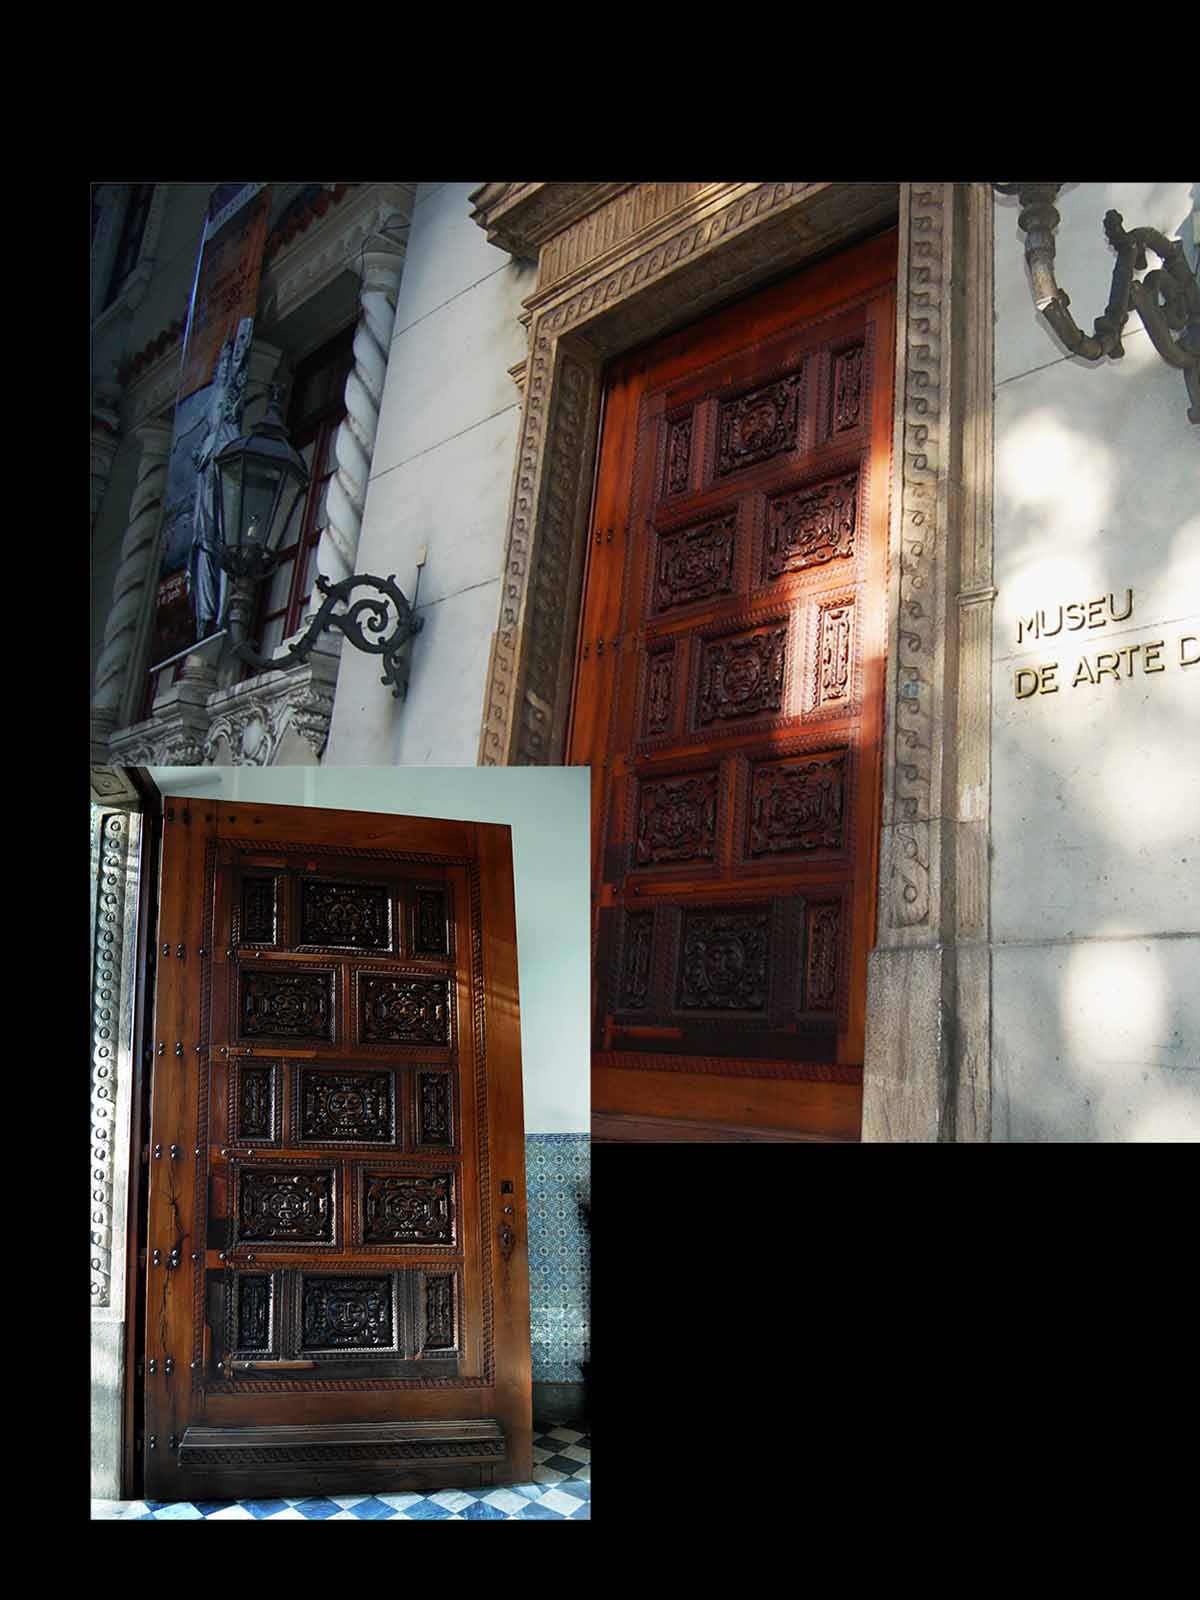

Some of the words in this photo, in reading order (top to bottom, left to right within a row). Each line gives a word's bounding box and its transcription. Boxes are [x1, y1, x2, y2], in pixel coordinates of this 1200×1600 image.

[1016, 588, 1135, 643] MUSEU
[1013, 662, 1059, 700] DE
[1071, 640, 1165, 688] ARTE
